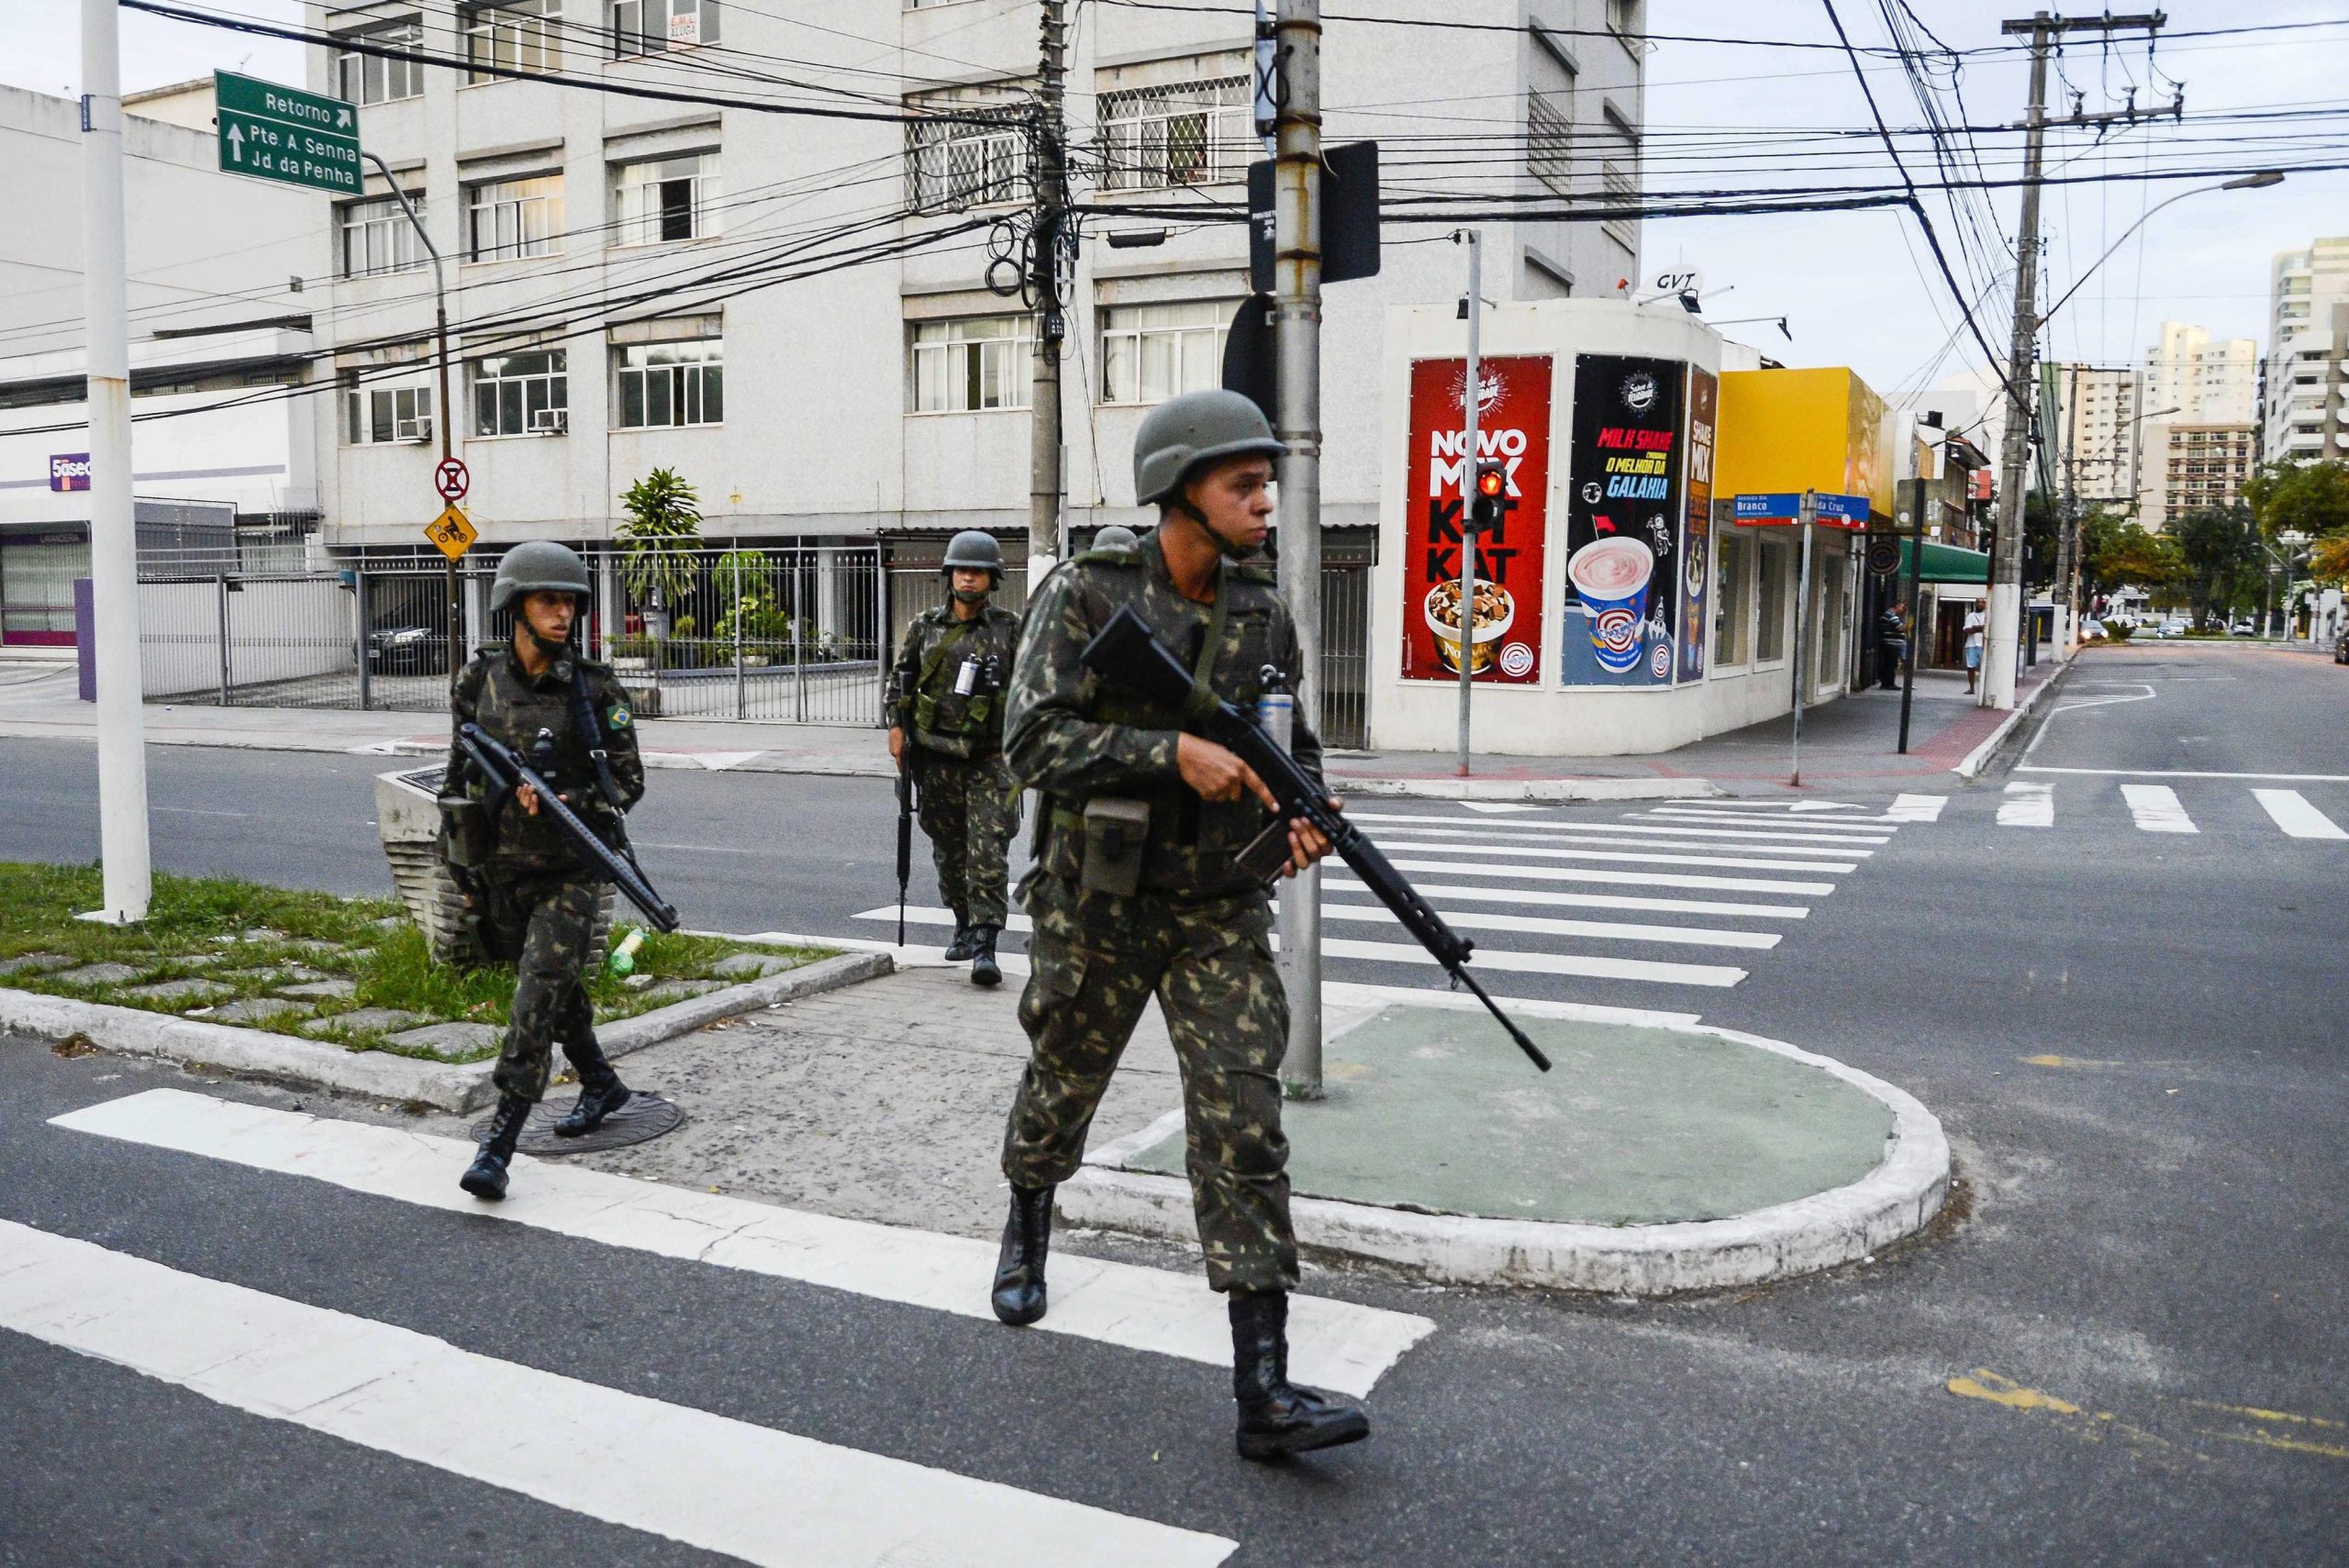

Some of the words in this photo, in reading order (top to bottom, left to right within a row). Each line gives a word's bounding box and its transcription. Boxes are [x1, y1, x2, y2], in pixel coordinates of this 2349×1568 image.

[265, 93, 330, 123] Retorno
[250, 125, 282, 147] Pte.
[287, 135, 301, 150] A.
[306, 138, 357, 162] Senna
[251, 150, 274, 170] Jd.
[280, 157, 299, 174] da
[305, 161, 354, 184] Penha
[1657, 272, 1696, 289] GVT
[1431, 428, 1527, 457] NOVO
[1598, 428, 1636, 449] MILK
[1635, 430, 1674, 451] SHAKE
[1430, 457, 1523, 496] MX
[1606, 457, 1616, 473] O
[1615, 458, 1654, 474] MELHOR
[1653, 461, 1666, 475] DA
[1691, 442, 1710, 484] MIX
[1737, 501, 1767, 511] Branco
[1818, 501, 1826, 510] da
[1829, 501, 1844, 512] Cruz
[1429, 500, 1519, 543] KT
[1427, 548, 1518, 584] KAT
